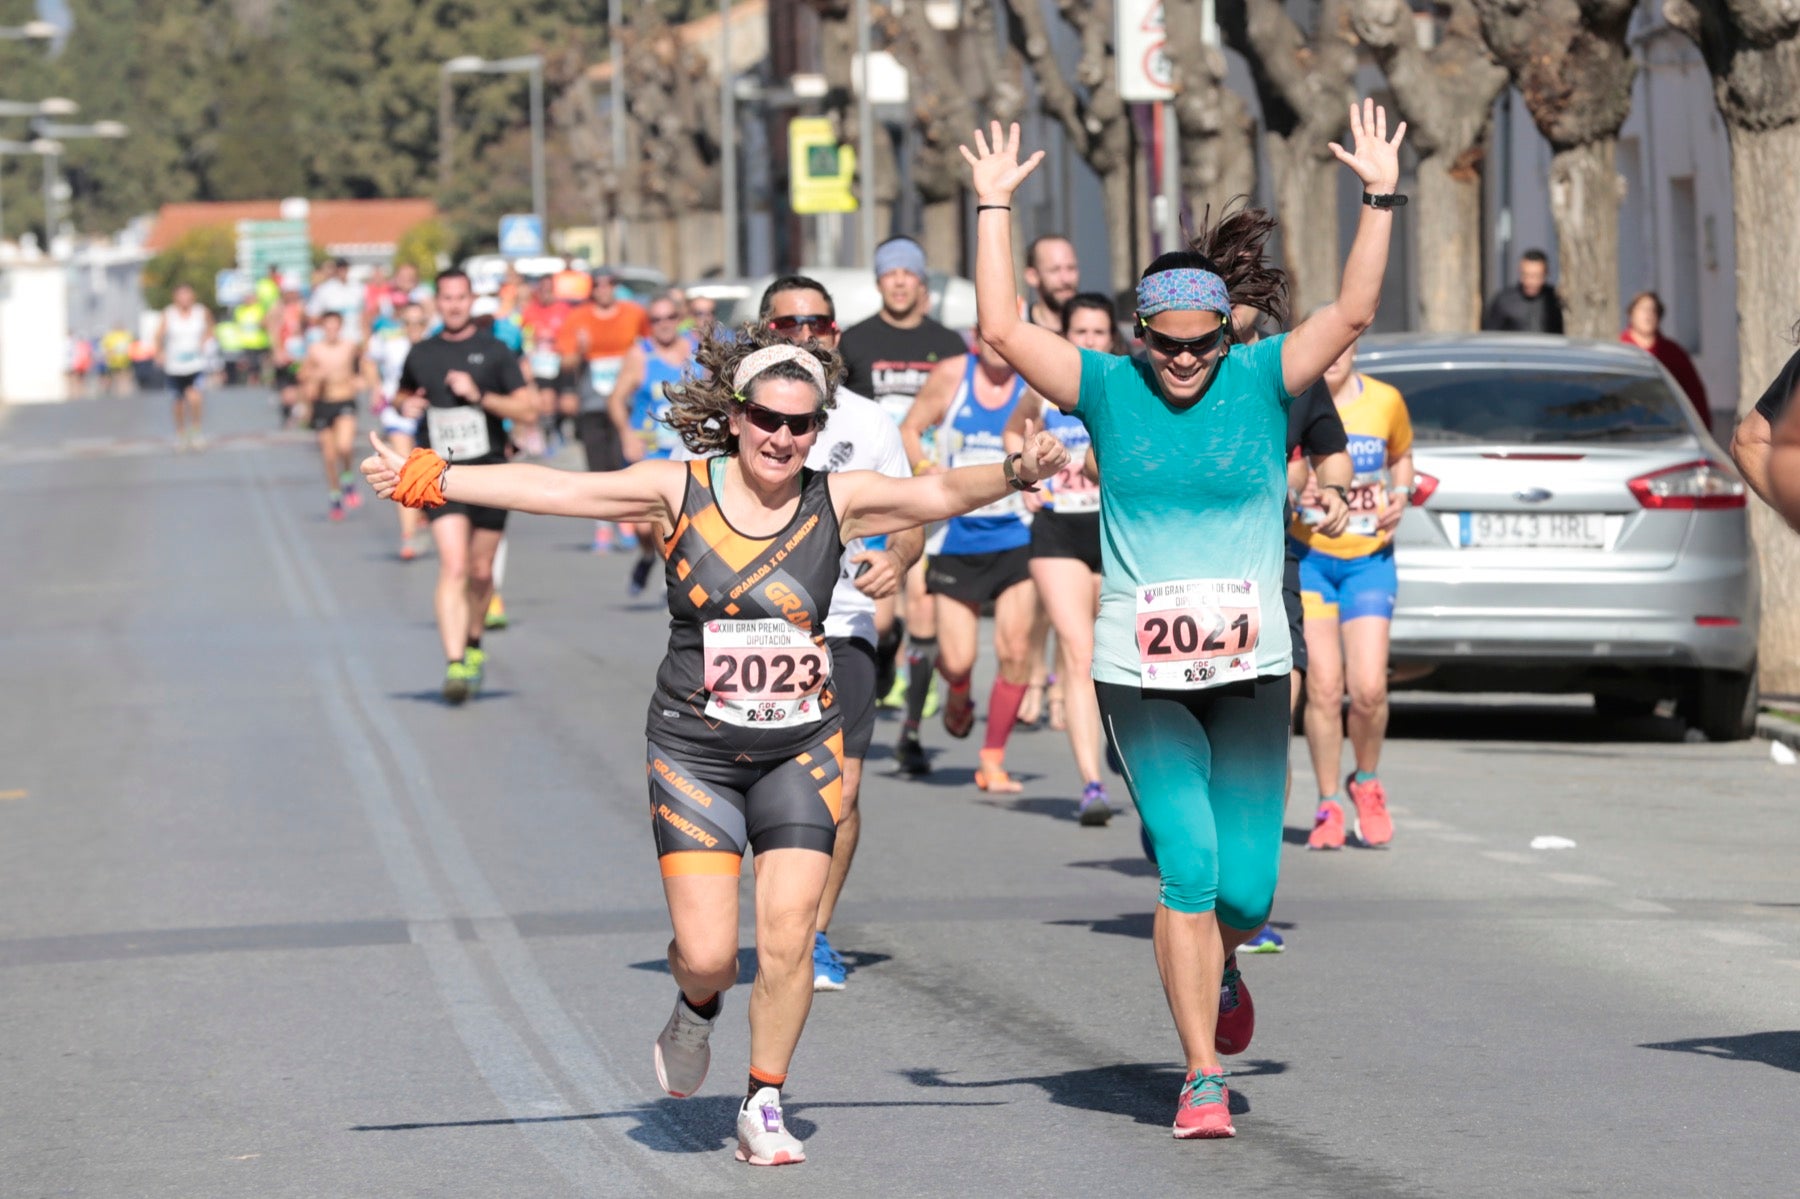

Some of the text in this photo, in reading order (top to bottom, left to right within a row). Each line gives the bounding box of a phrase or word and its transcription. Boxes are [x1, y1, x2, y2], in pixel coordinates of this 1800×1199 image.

[1478, 514, 1597, 540] 9343 HRL
[730, 514, 819, 599] GRANADA X EL RUNNING
[1165, 585, 1185, 596] GRAN
[736, 623, 756, 633] GRAN
[759, 622, 785, 633] PREMIO
[1144, 613, 1249, 655] 2021
[712, 654, 821, 694] 2023
[653, 758, 713, 808] GRANADA
[658, 804, 719, 848] RUNNING
